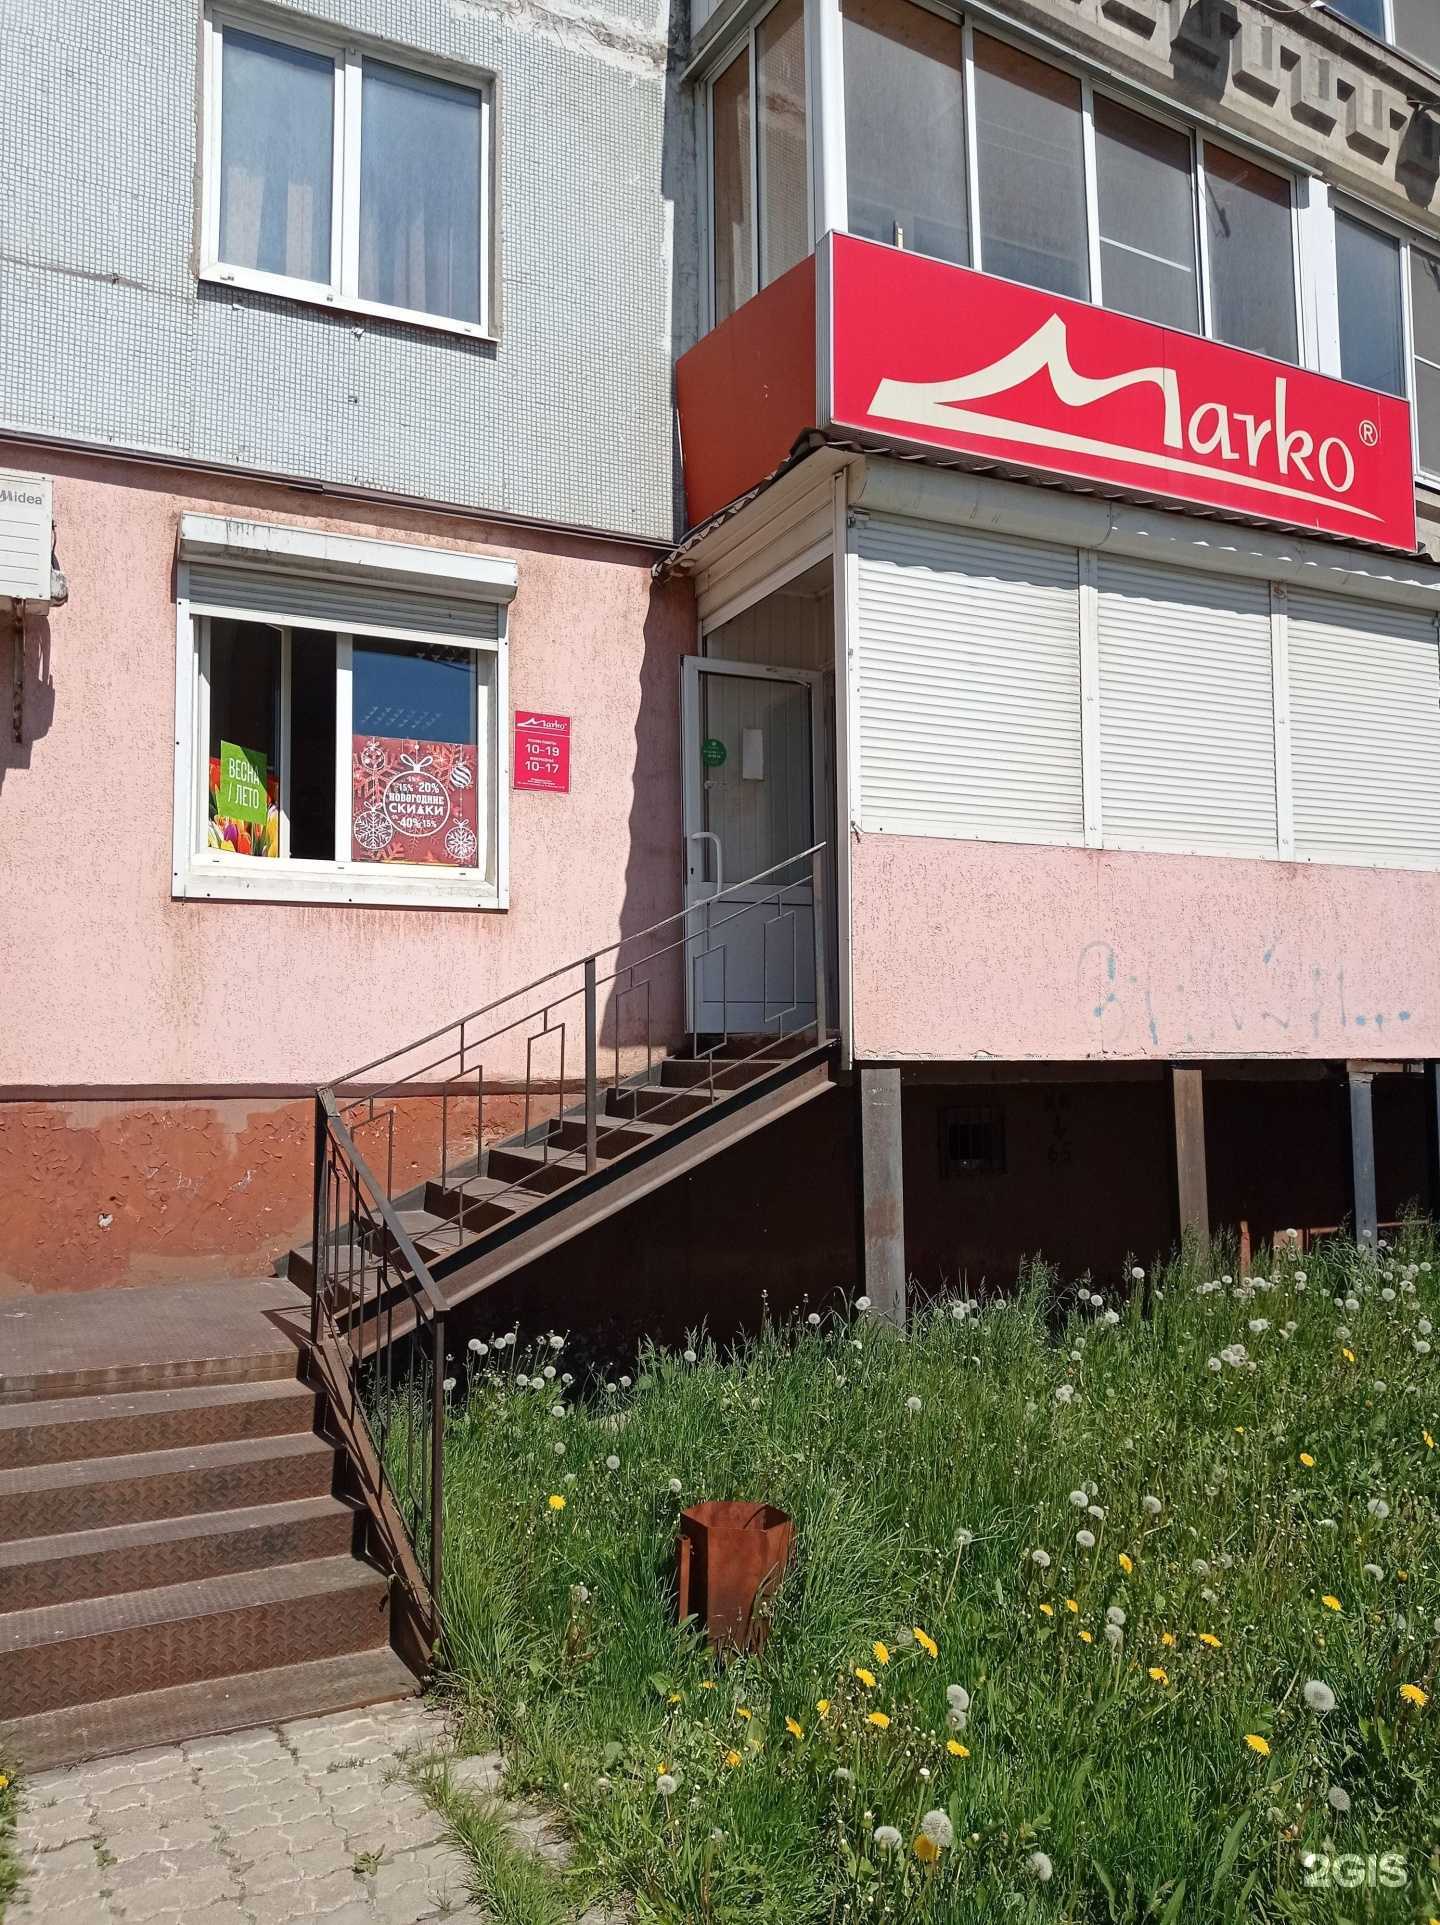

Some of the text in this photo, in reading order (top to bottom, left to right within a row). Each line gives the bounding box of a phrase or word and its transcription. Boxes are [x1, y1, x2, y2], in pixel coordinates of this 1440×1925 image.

[867, 313, 1385, 523] Marko
[228, 758, 260, 786] ВЕСНА
[235, 784, 259, 809] ЛЕТО
[389, 792, 445, 806] НОВОГОДНИЕ
[389, 802, 444, 816] СКИДКИ
